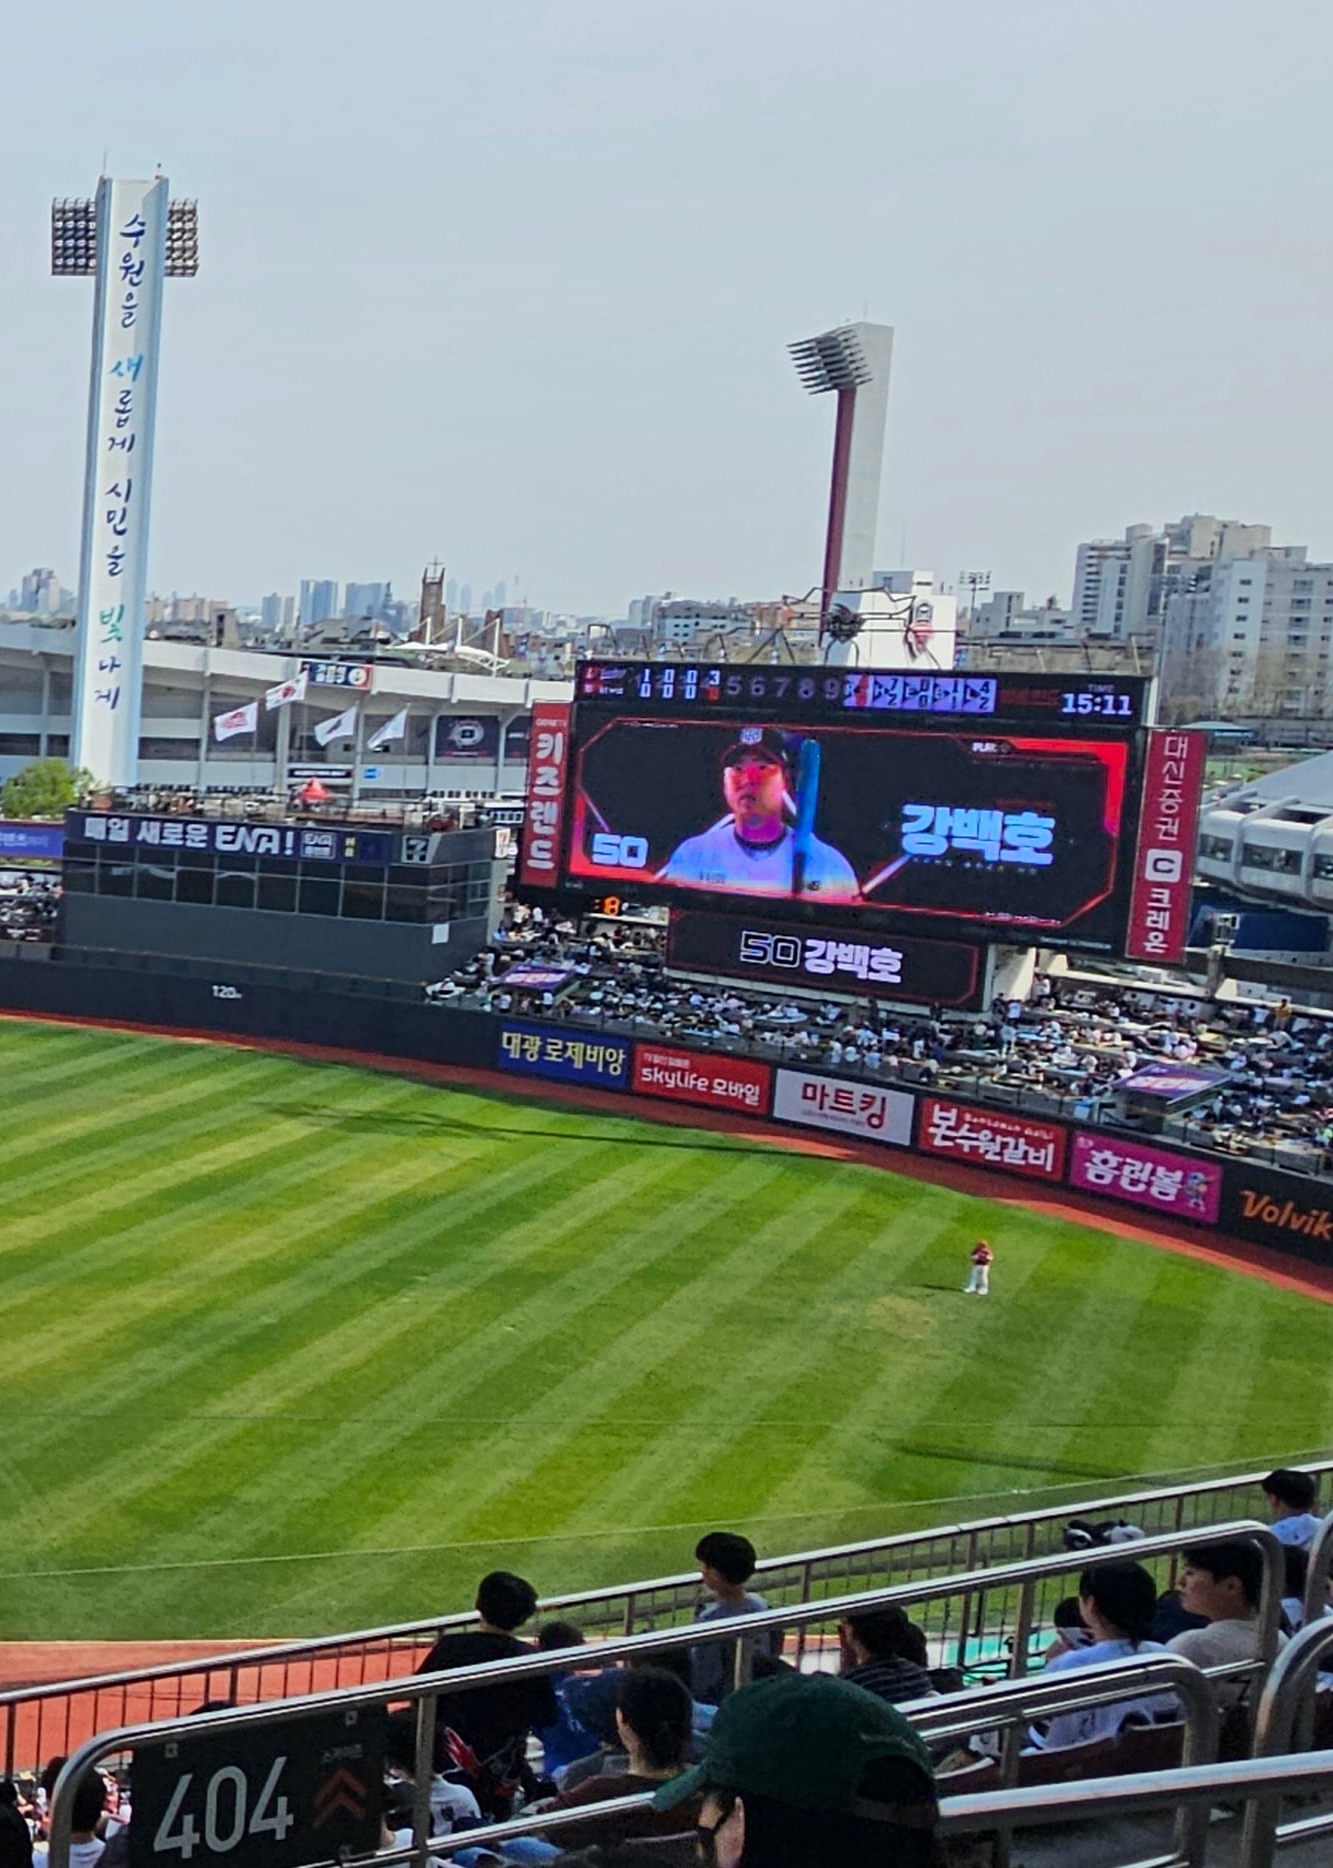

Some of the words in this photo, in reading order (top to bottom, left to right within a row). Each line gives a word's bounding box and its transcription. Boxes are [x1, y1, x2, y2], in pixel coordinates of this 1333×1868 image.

[119, 213, 147, 328] 수원을
[107, 353, 144, 454] 새롭게
[105, 477, 133, 577] 시민을
[93, 604, 126, 711] 빛나게
[1061, 693, 1132, 716] 15:11
[527, 732, 564, 870] 키즈랜드
[1154, 736, 1188, 841] 대신증권
[84, 817, 129, 843] 매일
[137, 819, 208, 848] 새로운
[591, 833, 649, 868] 50
[901, 803, 1056, 865] 강백호
[1143, 887, 1172, 954] 크레온
[739, 930, 801, 969] 50
[804, 938, 903, 984] 강백호
[501, 1030, 542, 1062] 대광
[543, 1039, 627, 1077] 로제비앙
[641, 1066, 709, 1092] skylife
[711, 1078, 760, 1106] 모바일
[802, 1082, 887, 1129] 마트킹
[928, 1104, 1055, 1172] 본수원갈비
[1084, 1149, 1185, 1201] 홈런볼
[1239, 1189, 1333, 1242] Volvik
[153, 1756, 294, 1859] 404
